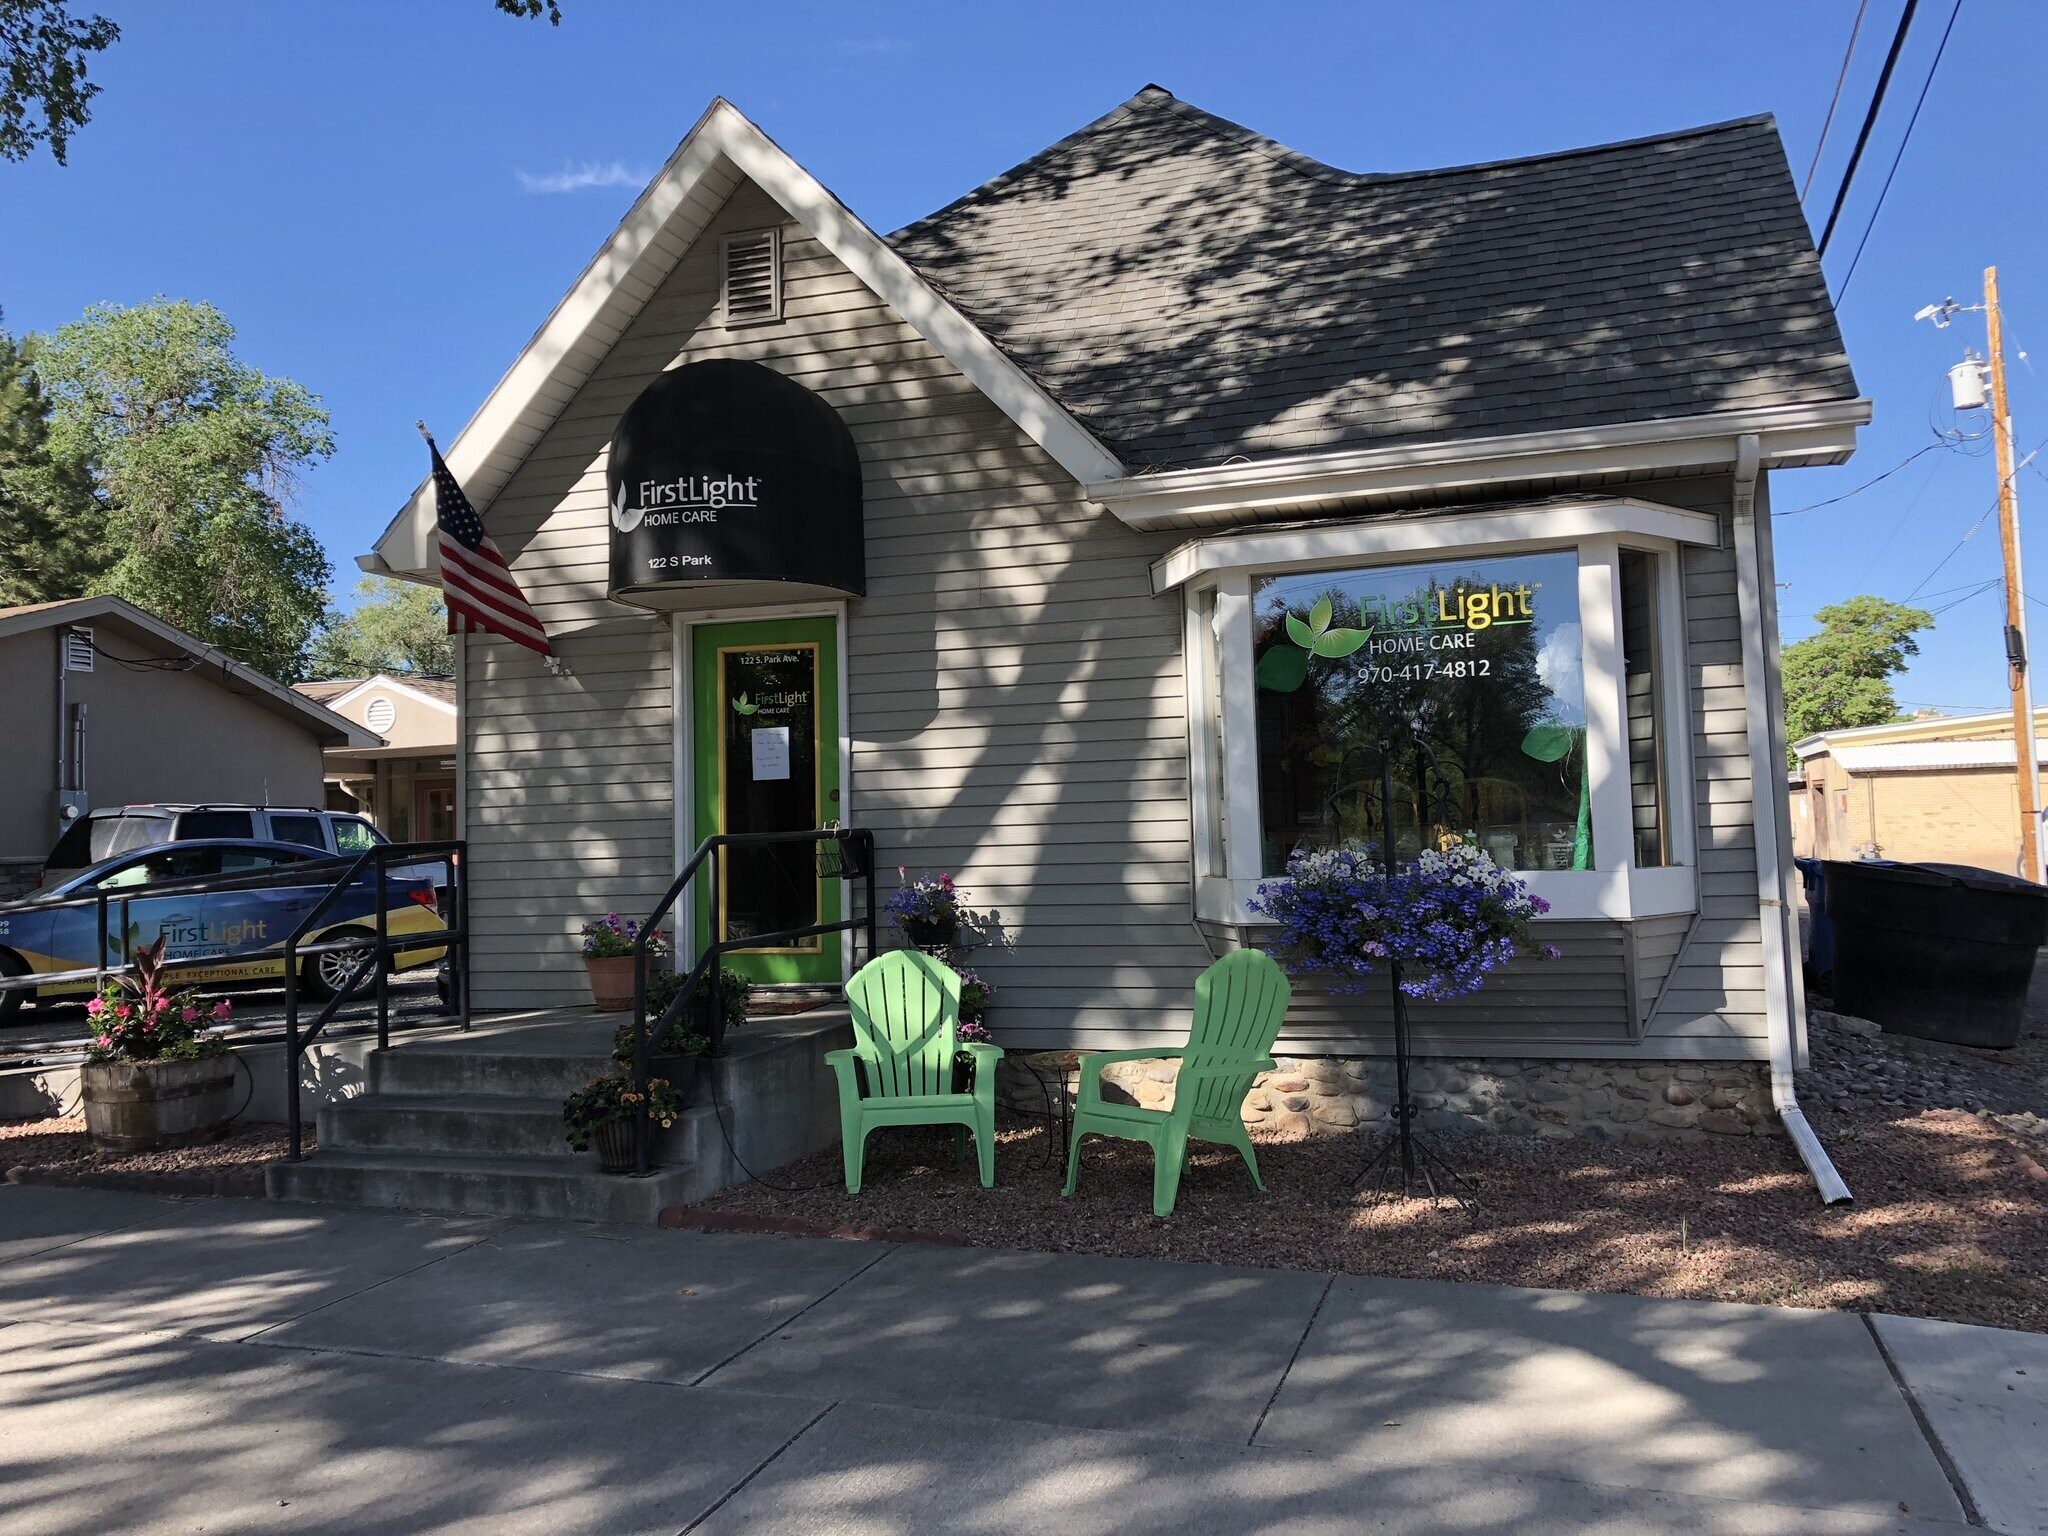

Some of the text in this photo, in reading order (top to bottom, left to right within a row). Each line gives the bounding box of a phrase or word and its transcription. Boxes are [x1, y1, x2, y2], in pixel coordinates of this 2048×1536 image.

[640, 474, 758, 508] FirstLight
[644, 510, 717, 527] HOME CARE
[648, 555, 713, 569] 122 S Park
[1360, 583, 1533, 629] FirstLight
[1369, 633, 1475, 654] HOME CARE
[740, 654, 800, 665] 122 S. Park Ave.
[1358, 659, 1490, 684] 970-417-4812
[755, 691, 808, 707] FirstLight
[757, 706, 790, 715] HOME CARE
[160, 920, 267, 946] FirstLight
[187, 968, 250, 979] EXCEPTIONAL
